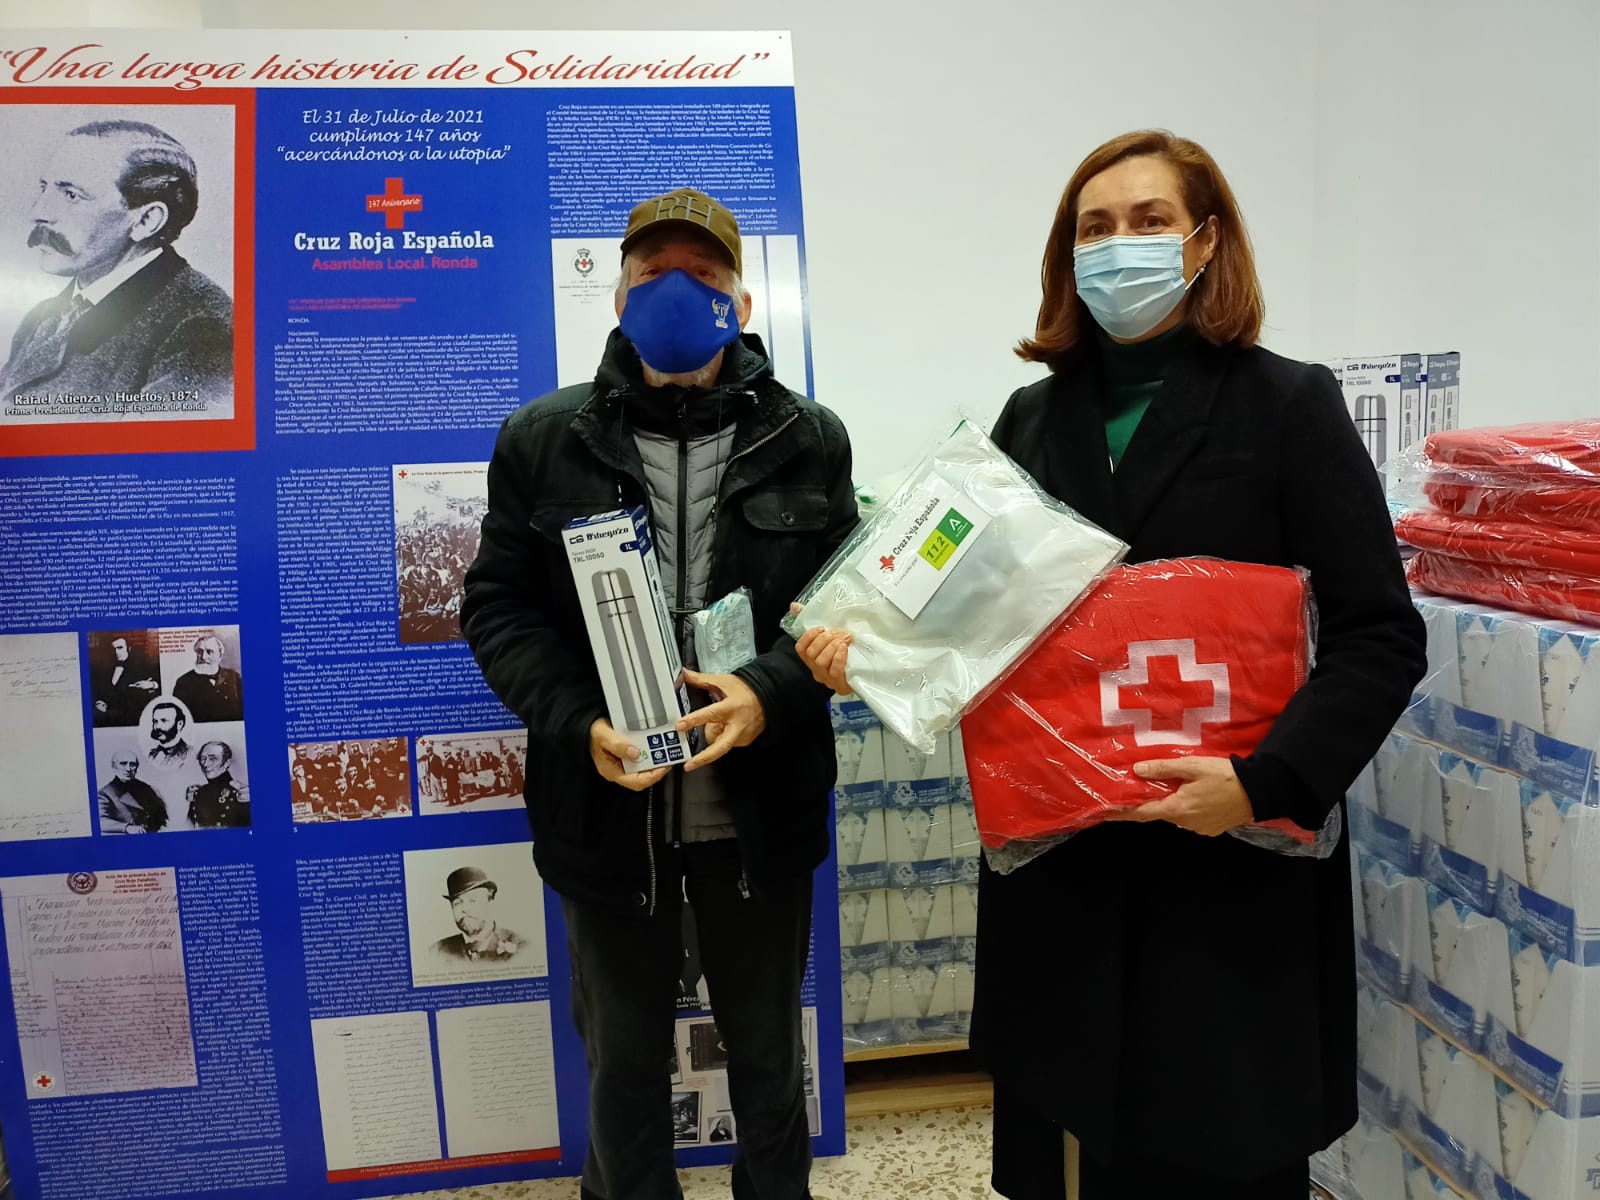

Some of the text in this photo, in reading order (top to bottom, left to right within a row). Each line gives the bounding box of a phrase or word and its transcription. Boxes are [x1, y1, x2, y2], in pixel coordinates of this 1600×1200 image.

[126, 54, 245, 90] larga
[251, 54, 418, 80] historia
[427, 54, 478, 79] de
[303, 109, 320, 124] El
[324, 110, 341, 124] 31
[349, 110, 371, 123] de
[420, 109, 444, 124] de
[446, 110, 483, 123] 2021
[310, 129, 480, 146] cumplimos 147 años
[410, 151, 423, 160] a
[426, 147, 446, 160] la
[369, 197, 421, 208] 147 Aniversario
[294, 231, 494, 254] Cruz Roja Española
[313, 257, 477, 270] Asamblea Local. Ronda
[15, 390, 198, 405] Rafael Atienza y Huertos, 1874
[6, 407, 32, 416] Primer
[35, 406, 77, 415] Presidente
[79, 405, 89, 413] de
[113, 404, 131, 414] Roja
[133, 404, 169, 414] Española
[171, 403, 180, 411] de
[183, 402, 207, 411] Ronda
[893, 540, 908, 555] Cruz
[915, 497, 940, 526] Española
[926, 536, 945, 559] 112
